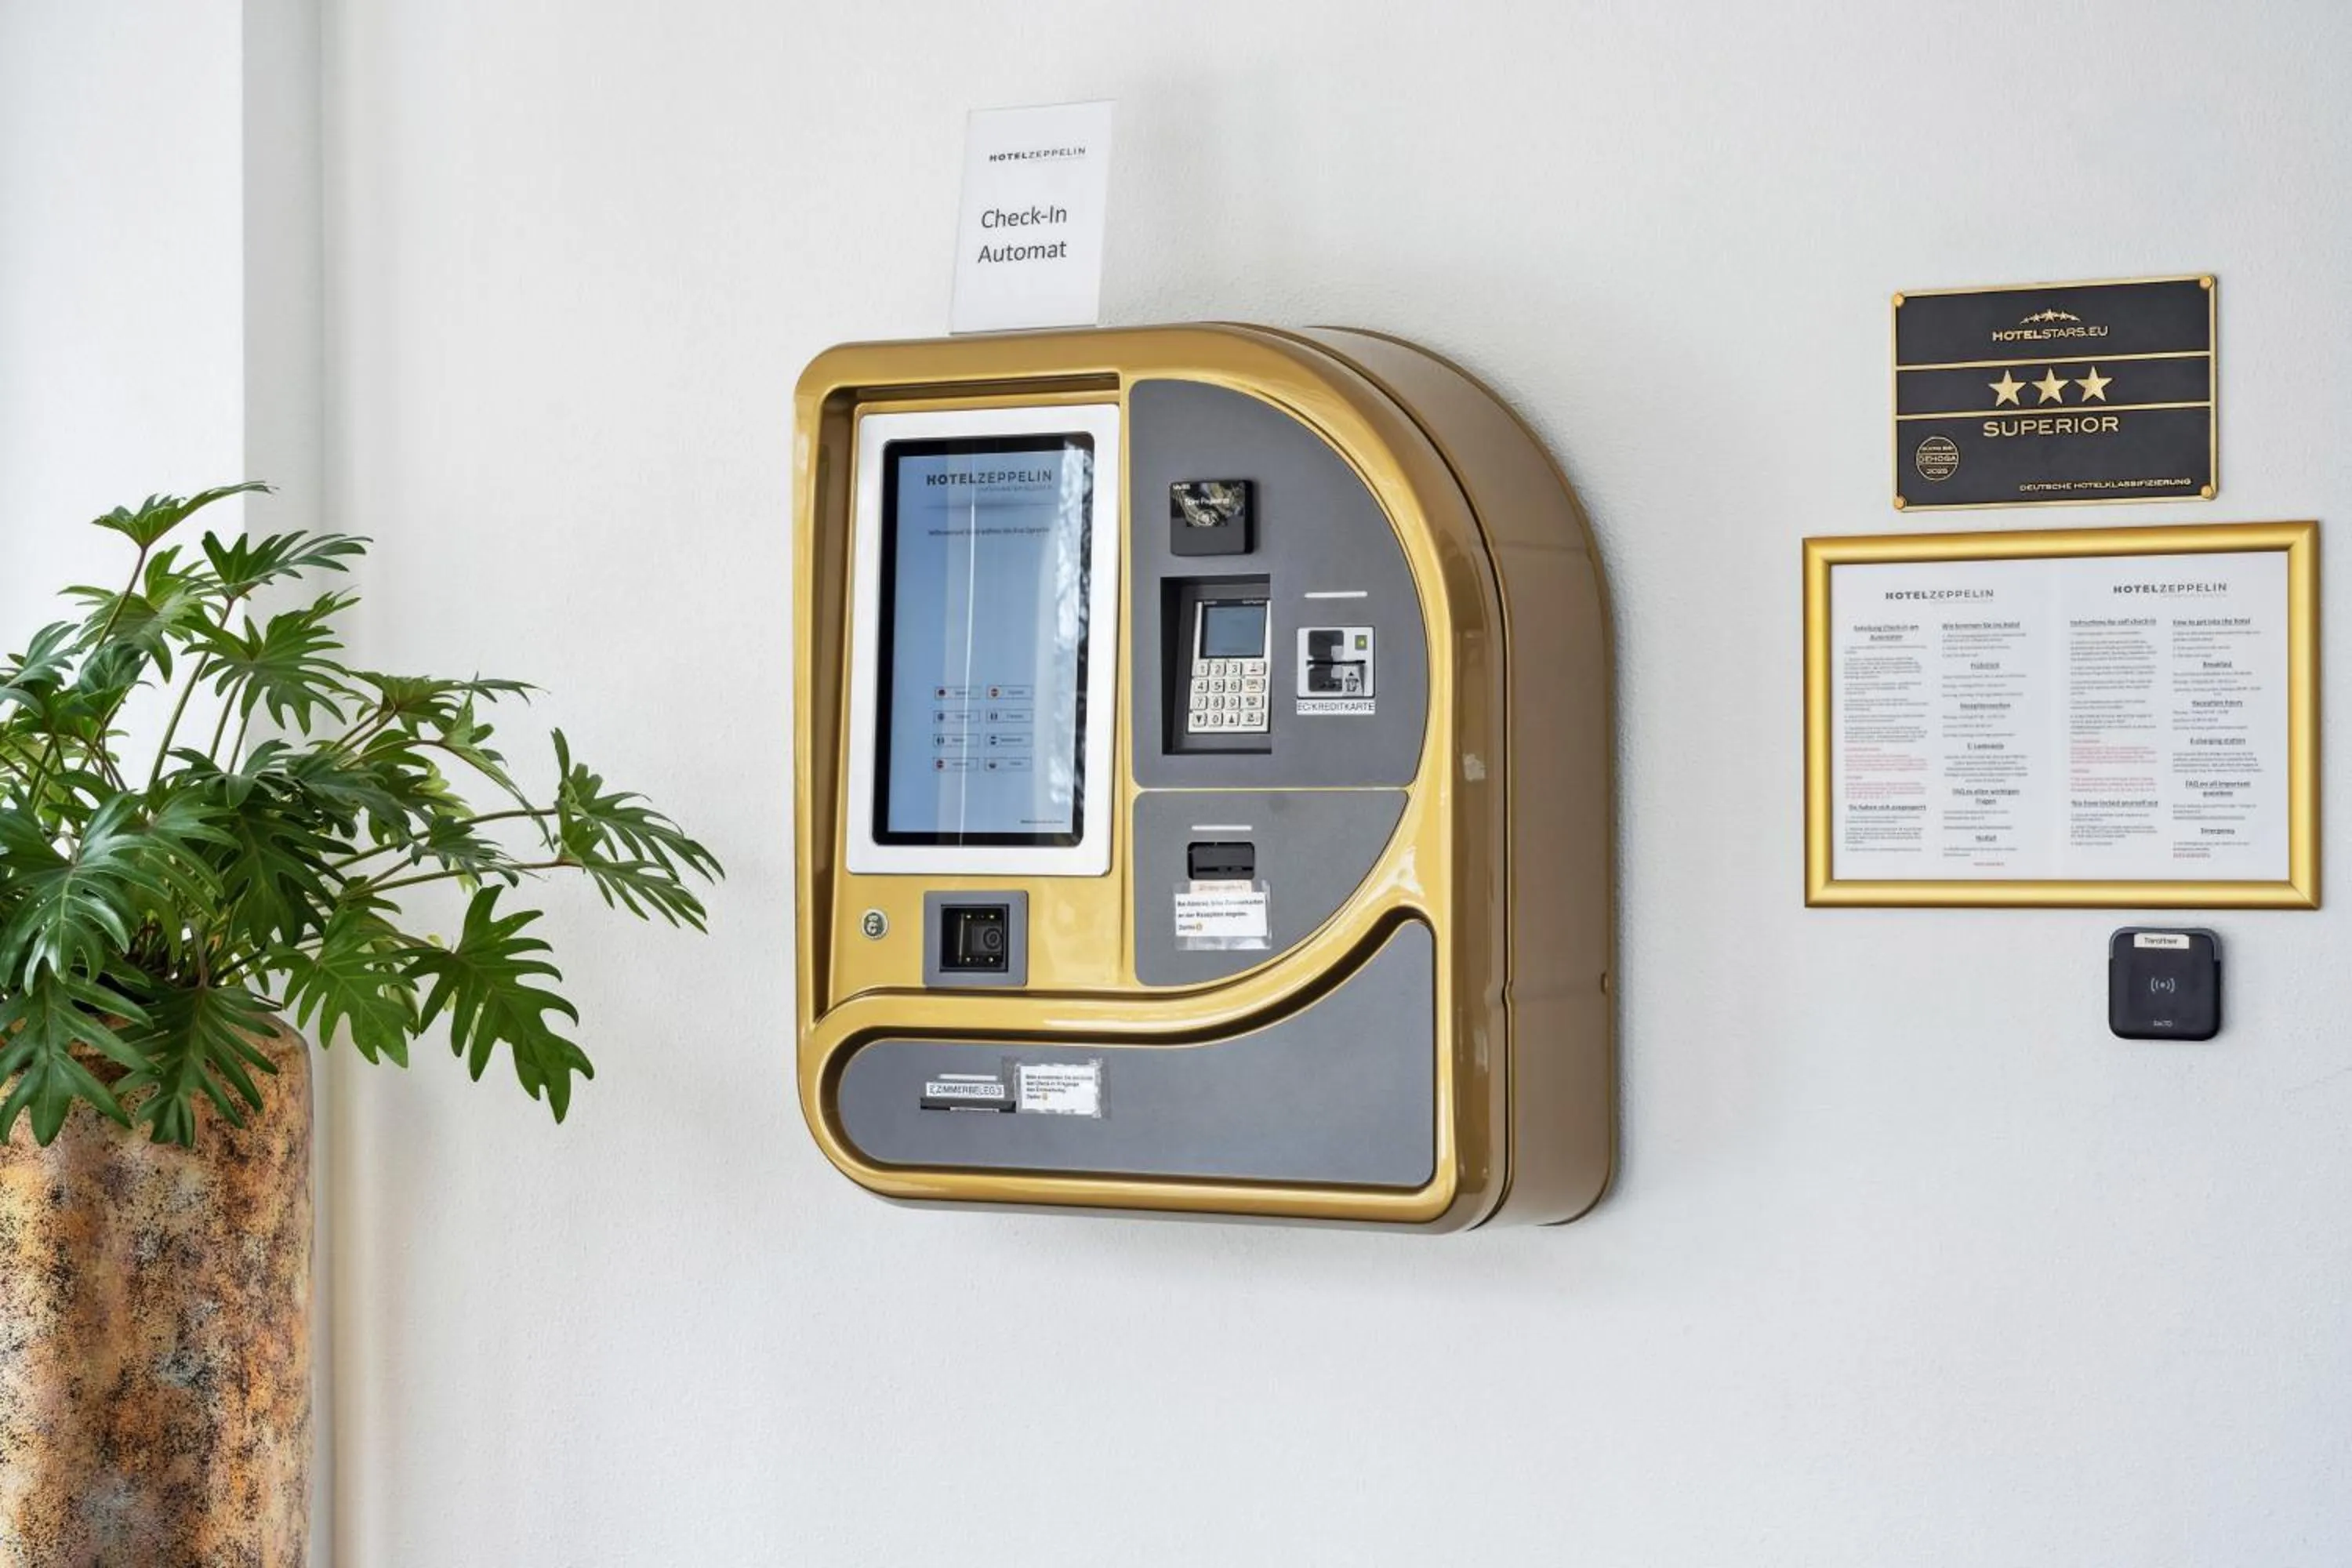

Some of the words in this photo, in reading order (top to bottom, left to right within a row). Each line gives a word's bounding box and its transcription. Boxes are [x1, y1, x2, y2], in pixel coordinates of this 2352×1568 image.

[989, 147, 1086, 162] HOTELZEPPELIN
[981, 205, 1067, 229] Check-In
[978, 241, 1067, 263] Automat
[1992, 325, 2108, 341] HOTELSTARS.EU
[1983, 416, 2120, 437] SUPERIOR
[926, 470, 1052, 486] HOTELZEPPELIN
[2019, 483, 2071, 492] DEUTSCHE
[2074, 477, 2191, 489] HOTELKLASSIFIZIERUNG
[1885, 589, 1994, 600] HOTELZEPPELIN
[2113, 583, 2227, 593] HOTELZEPPELIN
